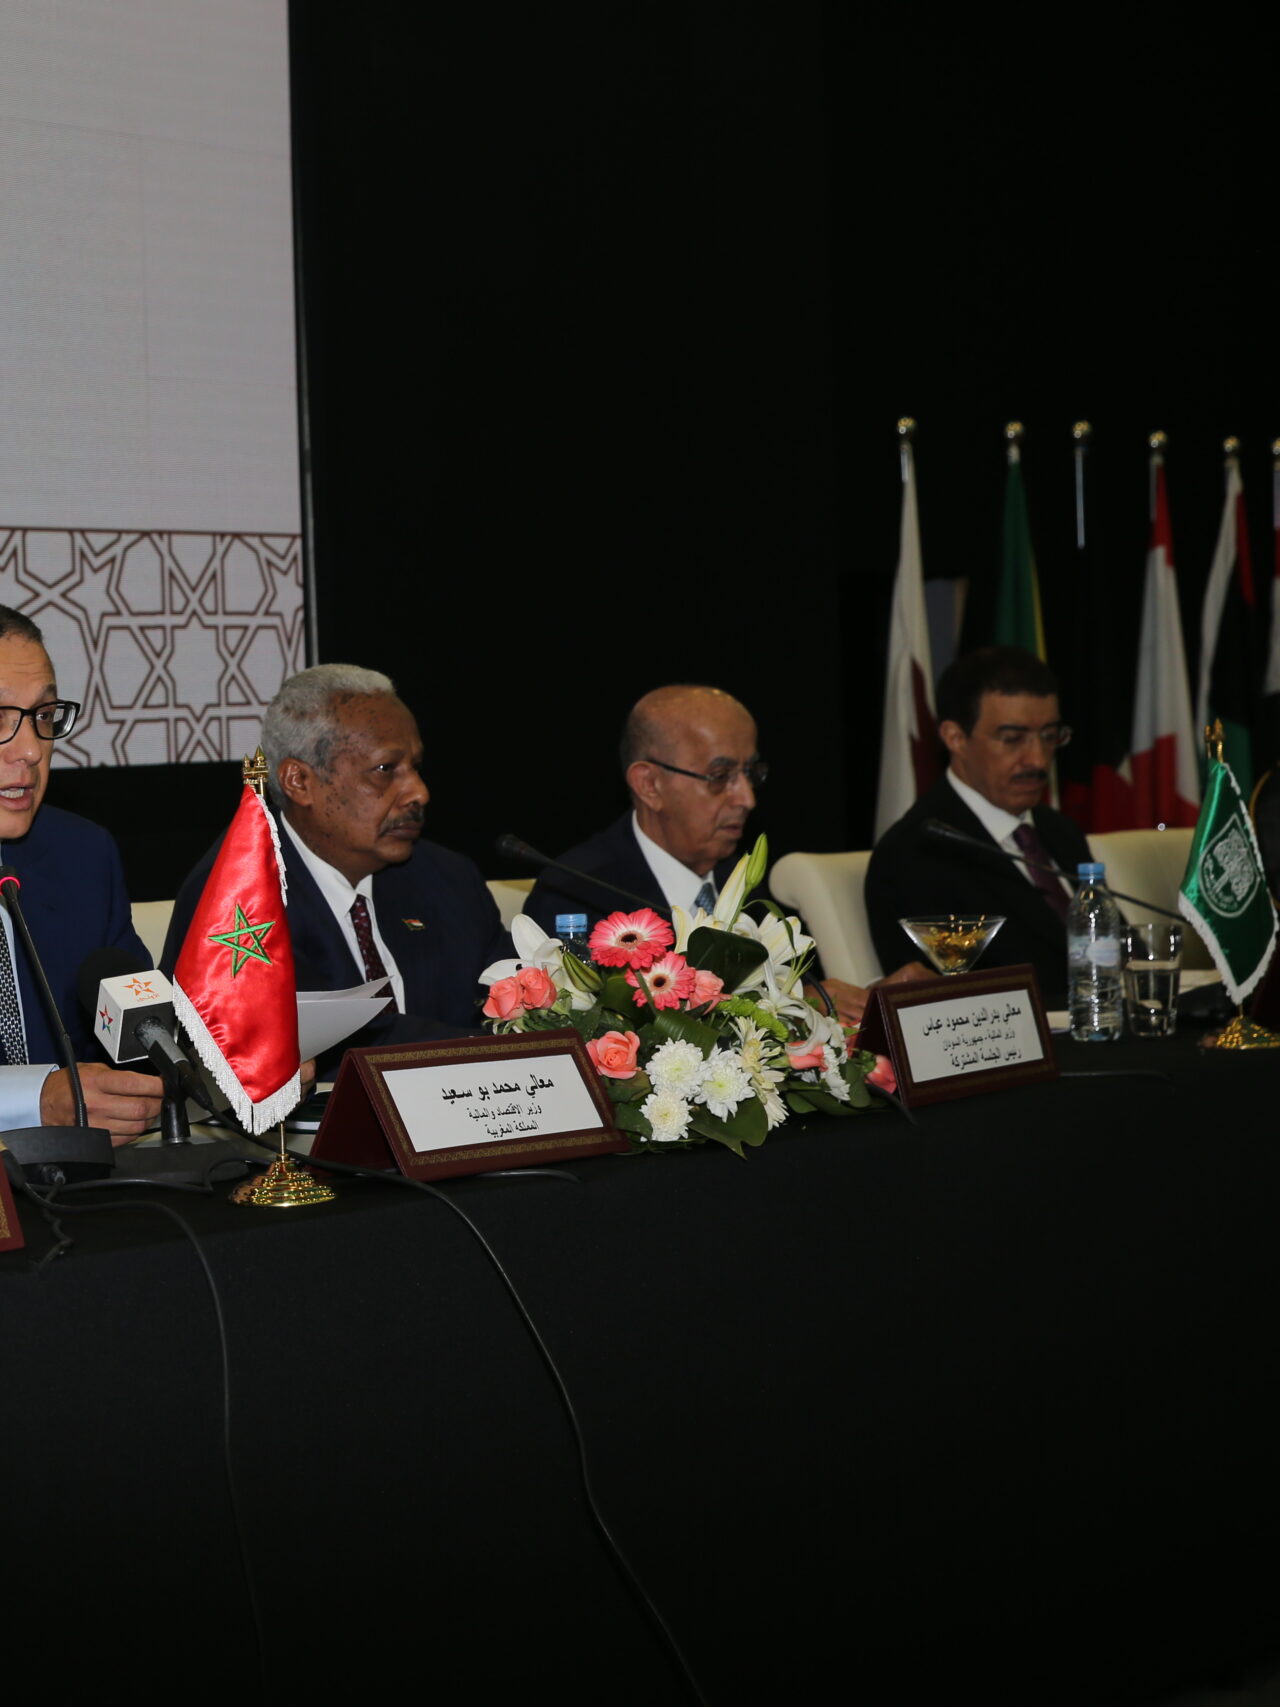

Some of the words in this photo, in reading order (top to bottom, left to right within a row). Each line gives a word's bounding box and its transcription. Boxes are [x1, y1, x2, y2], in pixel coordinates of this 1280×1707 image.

[478, 1085, 491, 1102] بو
[492, 1081, 522, 1095] محمد
[525, 1073, 554, 1099] معالي
[441, 1087, 473, 1105] سعيد
[512, 1119, 539, 1132] المملكة
